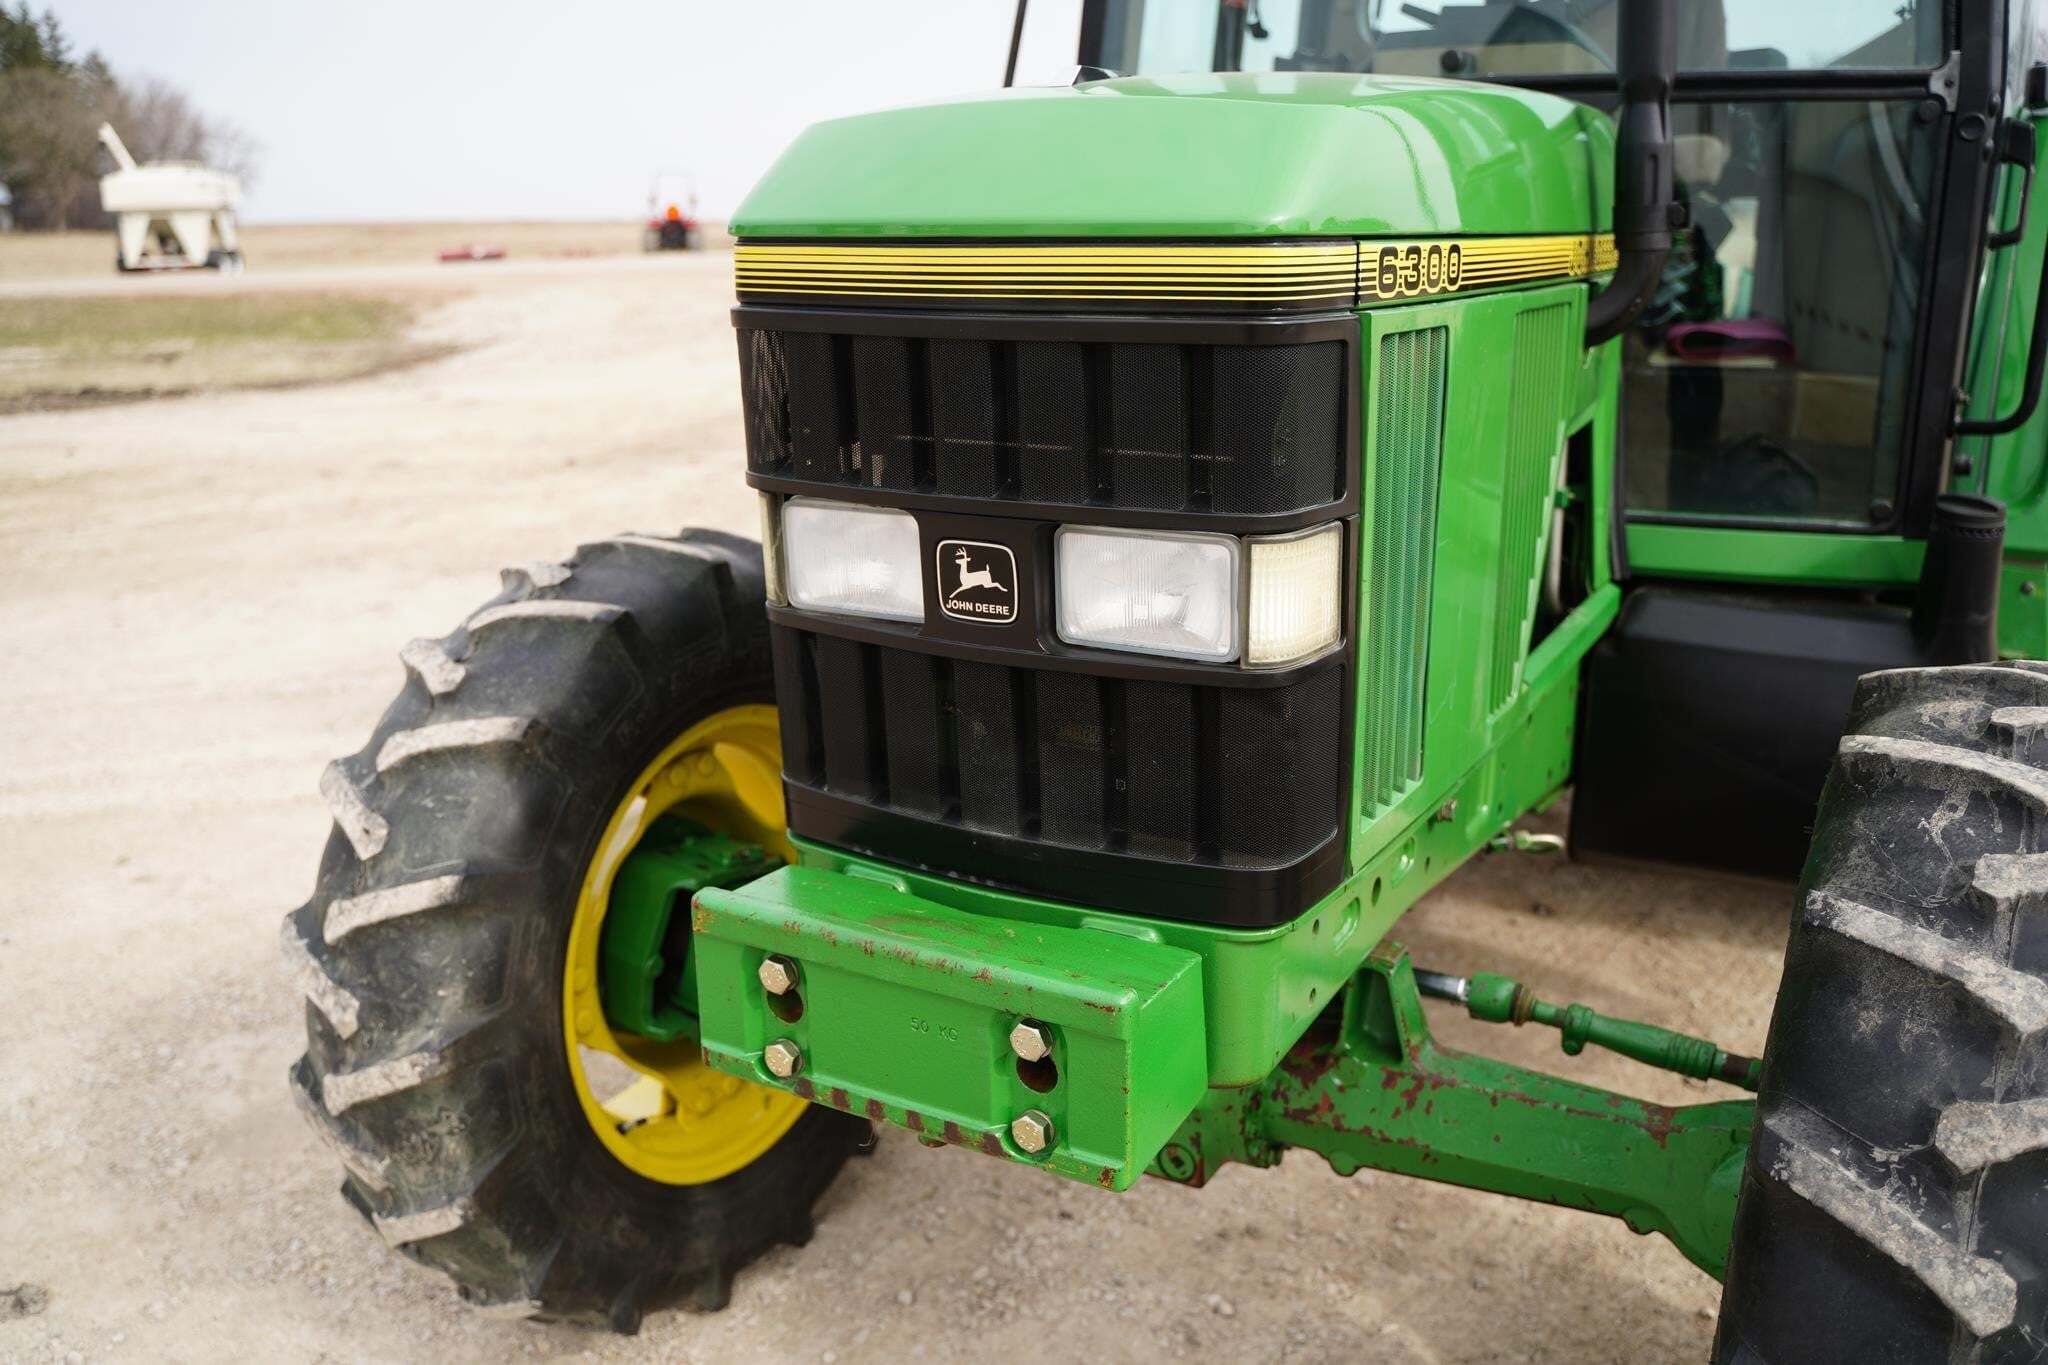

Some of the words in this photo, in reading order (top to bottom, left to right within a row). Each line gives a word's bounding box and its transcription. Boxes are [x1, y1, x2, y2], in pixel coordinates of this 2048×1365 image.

[1377, 244, 1462, 298] 6300
[946, 600, 973, 611] JOHN
[975, 603, 1010, 615] DEERE
[911, 1017, 929, 1033] 50
[937, 1023, 959, 1041] KG
